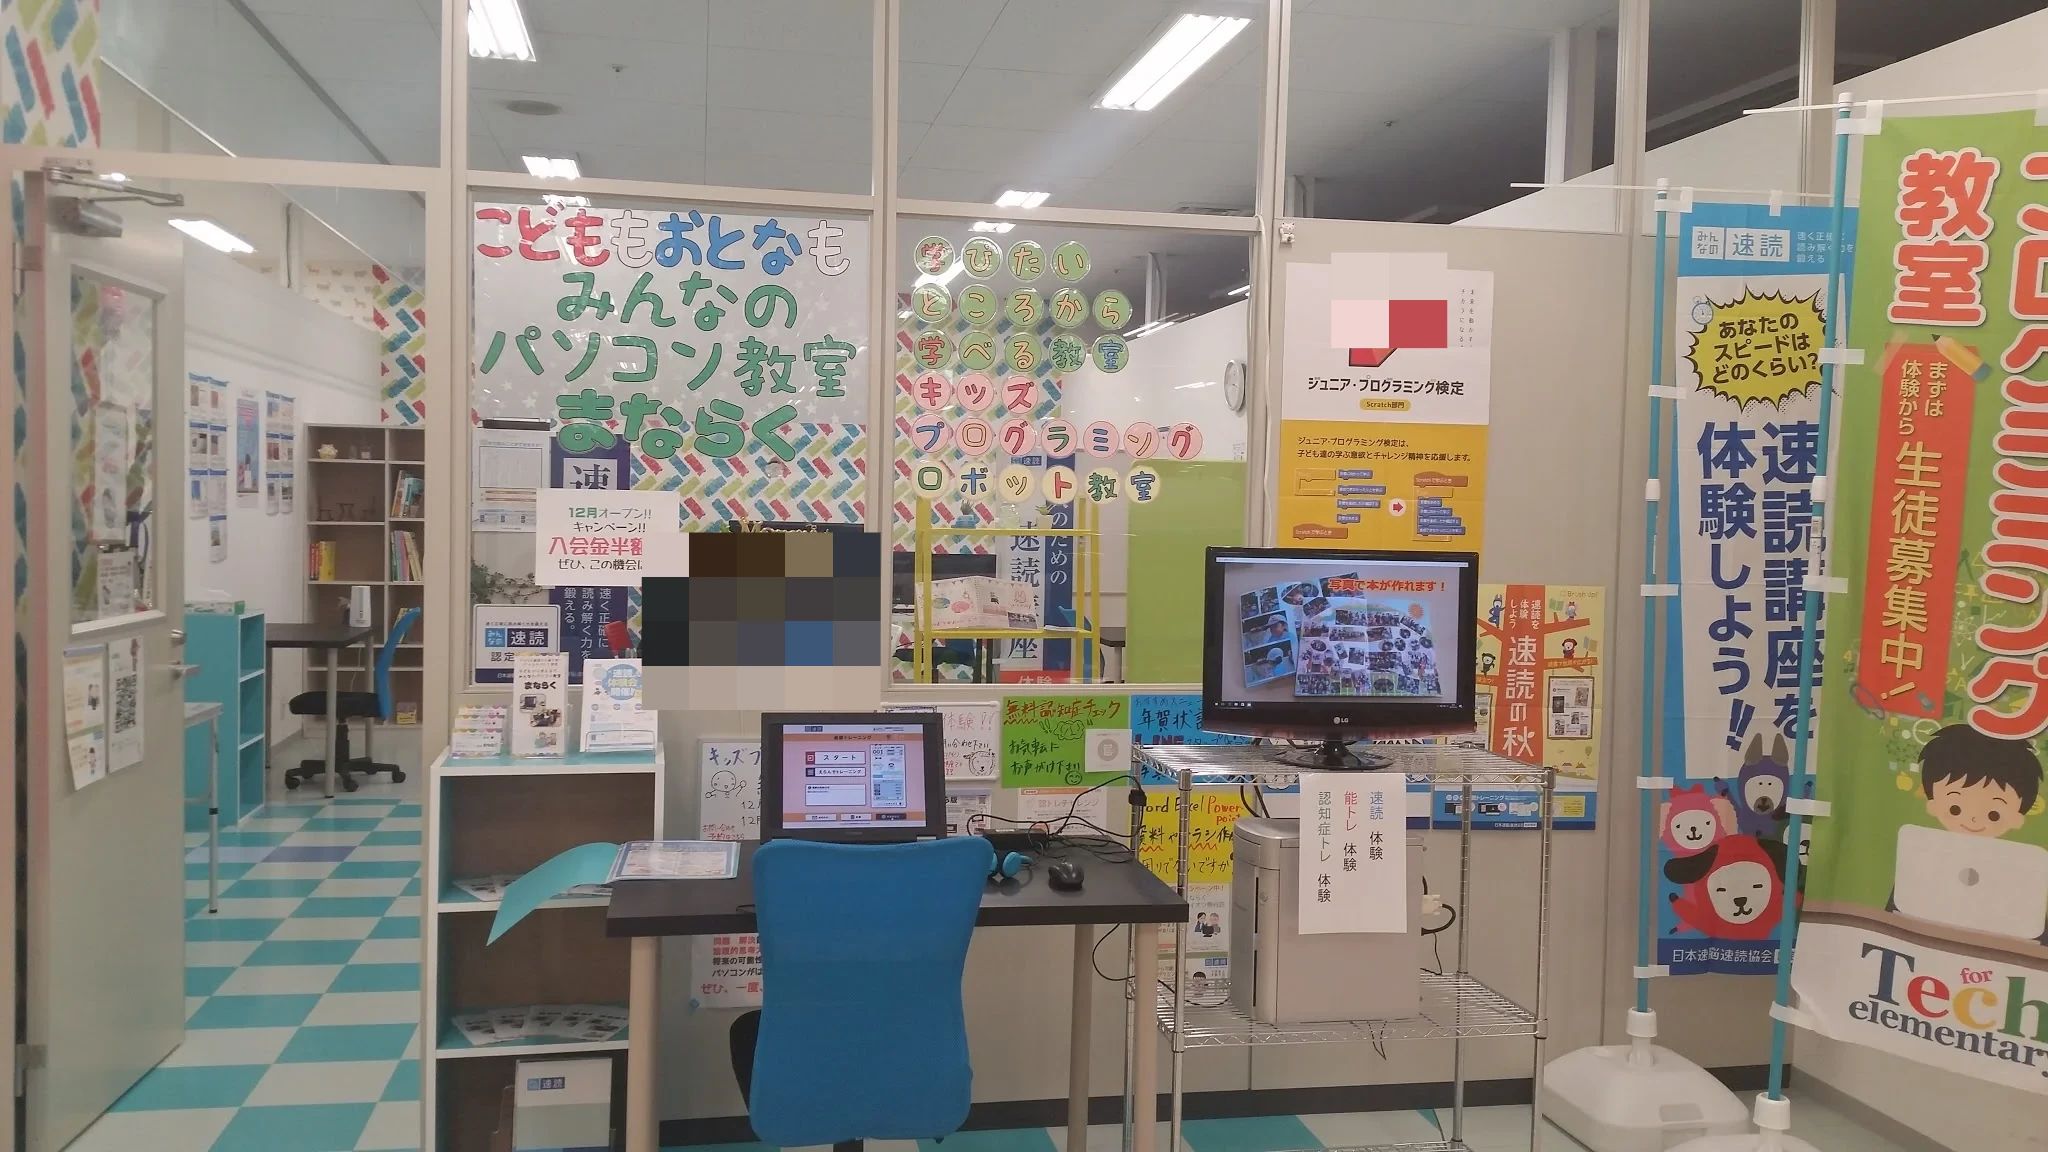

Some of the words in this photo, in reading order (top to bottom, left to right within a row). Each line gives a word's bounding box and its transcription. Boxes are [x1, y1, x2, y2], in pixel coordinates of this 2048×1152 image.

[476, 202, 851, 276] こどももおとなも
[1731, 233, 1784, 258] 速読
[1889, 148, 2000, 325] 教室
[920, 243, 1084, 277] 学びたい
[556, 270, 798, 332] みんなの
[921, 292, 1121, 325] ところから
[1719, 312, 1799, 339] あなたの
[479, 324, 858, 399] パソコン教室
[918, 336, 1124, 370] 学べる教室
[1713, 332, 1810, 363] スピードは
[1712, 352, 1820, 384] どのくらい?
[920, 376, 1034, 411] キッズ
[1366, 400, 1405, 409] Scratch部門
[1898, 359, 1924, 436] 体験から
[1923, 361, 1949, 417] まずは
[555, 388, 798, 463] まならく
[915, 421, 1195, 458] プログラミング
[917, 465, 1157, 501] ロボット教室
[568, 506, 653, 520] 12月オープン!!
[572, 521, 647, 533] キャンペーン!!
[1328, 578, 1446, 593] 写真で本が作れます!
[1697, 421, 1758, 752] 体験しよう!!
[1761, 420, 1827, 740] 速読講座を
[1880, 440, 1944, 701] 生徒募集中!
[1007, 521, 1041, 660] 速読座
[563, 587, 577, 632] 鍛える。
[580, 587, 595, 661] 読み解く力を
[1508, 598, 1519, 629] しよう
[1519, 599, 1530, 620] 体験
[1530, 599, 1543, 630] 速読を
[510, 630, 545, 646] 速読
[490, 651, 515, 662] 認定
[524, 681, 557, 690] まならく
[1502, 634, 1537, 758] 速読の秋
[1144, 796, 1169, 813] ord
[1343, 791, 1358, 832] 能トレ
[1370, 791, 1384, 820] 速読
[1139, 825, 1234, 844] 資料やラシ作
[1317, 791, 1332, 862] 認知症トレ
[1343, 842, 1358, 872] 体験
[1369, 831, 1384, 861] 体験
[1317, 873, 1332, 903] 体験
[1960, 967, 1993, 984] for
